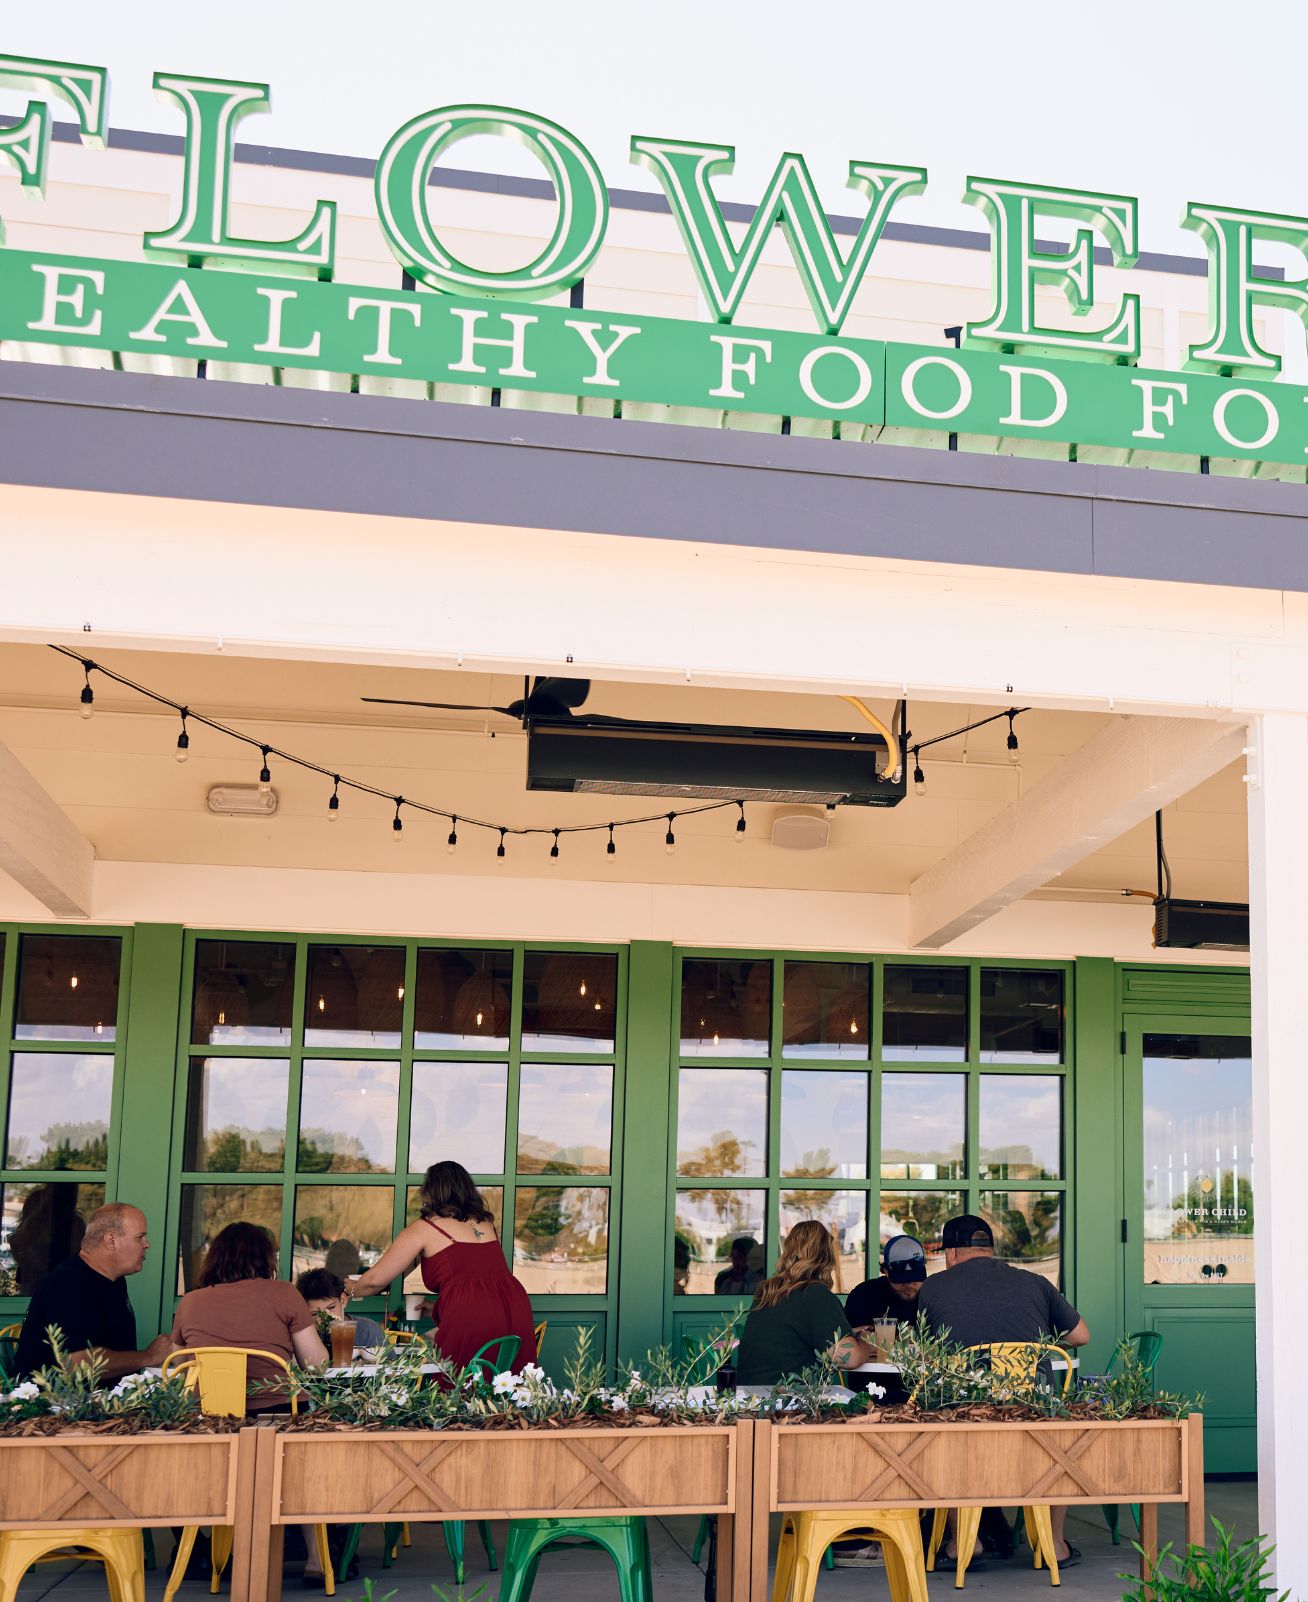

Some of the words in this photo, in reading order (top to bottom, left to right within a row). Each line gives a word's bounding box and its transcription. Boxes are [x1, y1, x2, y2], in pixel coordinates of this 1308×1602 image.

[27, 264, 641, 387] EALTHY
[709, 335, 1068, 427] FOOD
[1131, 379, 1308, 453] FO
[1161, 1208, 1209, 1216] OWER
